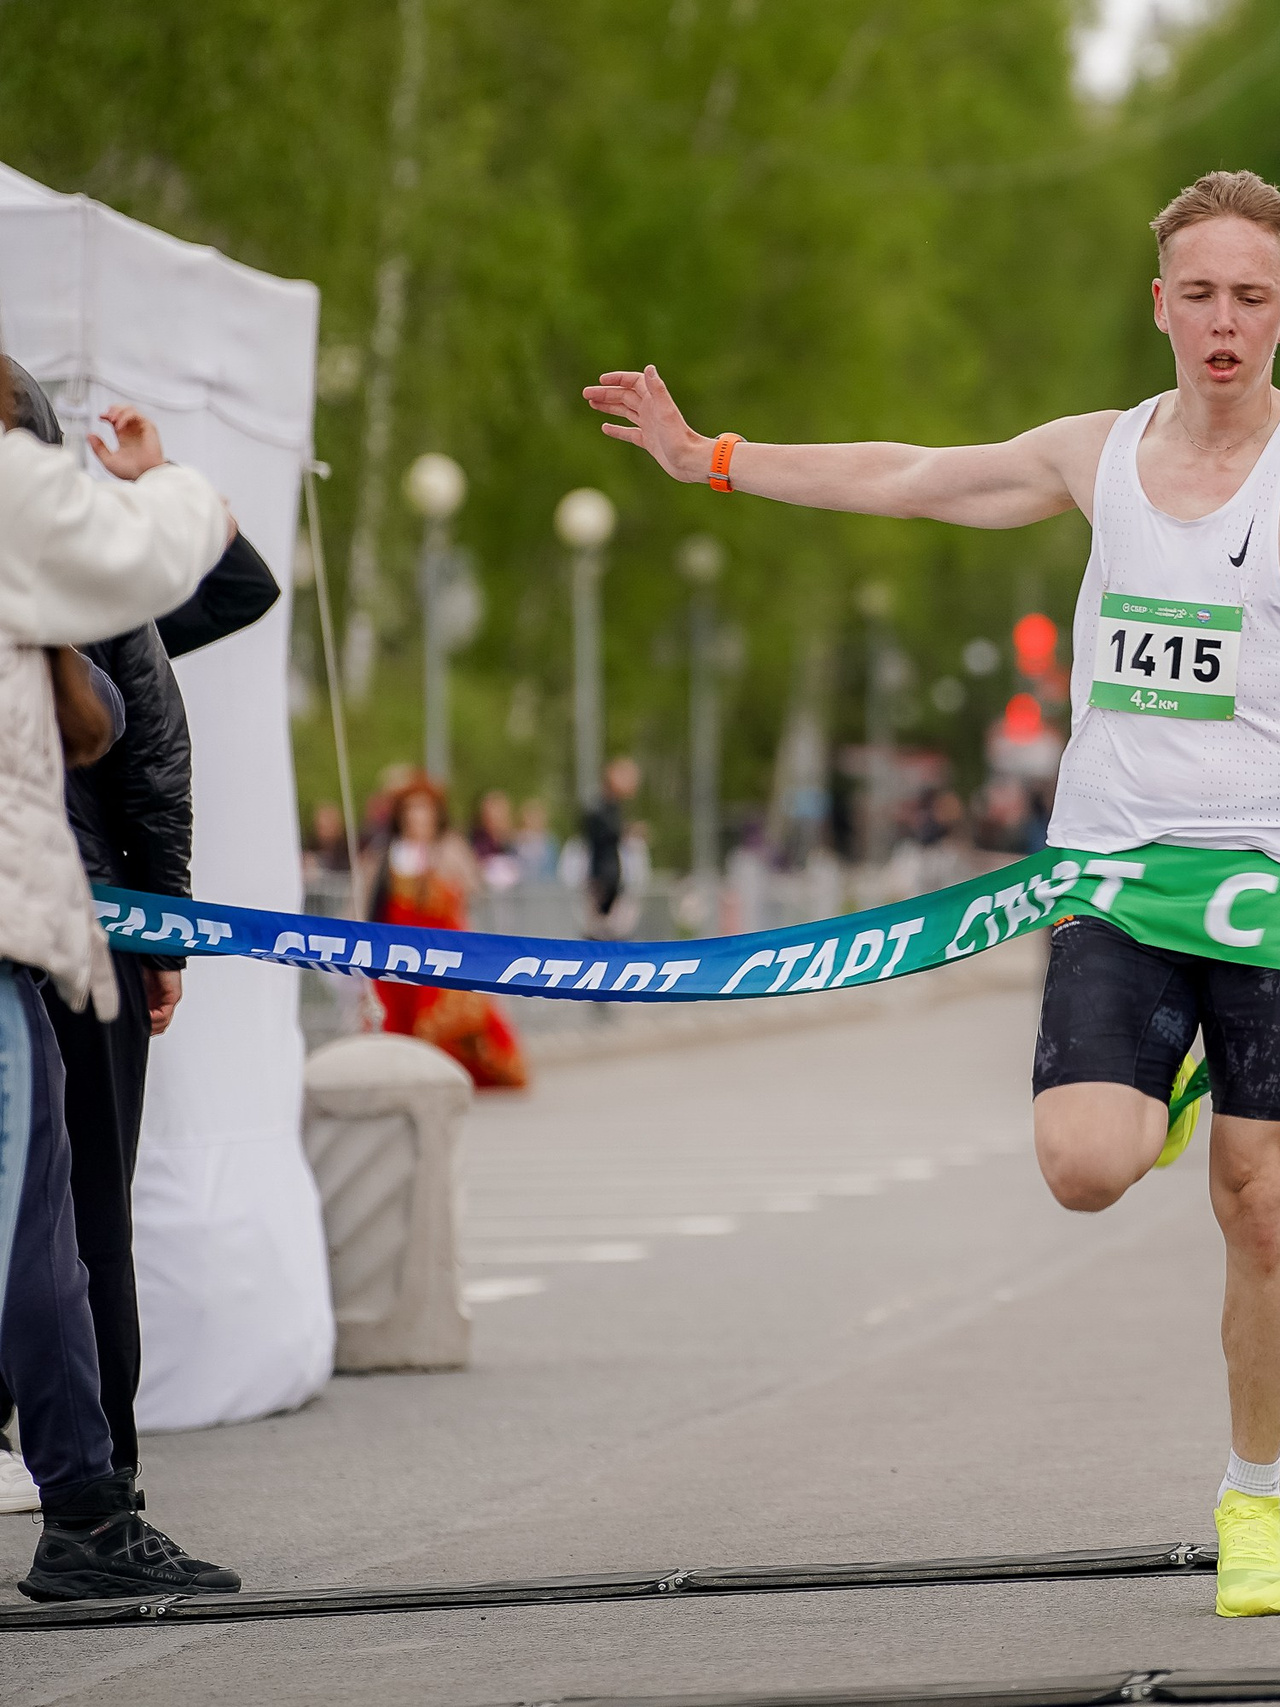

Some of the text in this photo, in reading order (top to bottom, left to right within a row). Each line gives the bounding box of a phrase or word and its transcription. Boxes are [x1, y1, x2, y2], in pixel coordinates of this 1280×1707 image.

[1110, 629, 1222, 683] 1415
[1130, 690, 1158, 710] 4,2
[718, 916, 925, 994] СТАРТ
[945, 859, 1146, 959] СТАРТ
